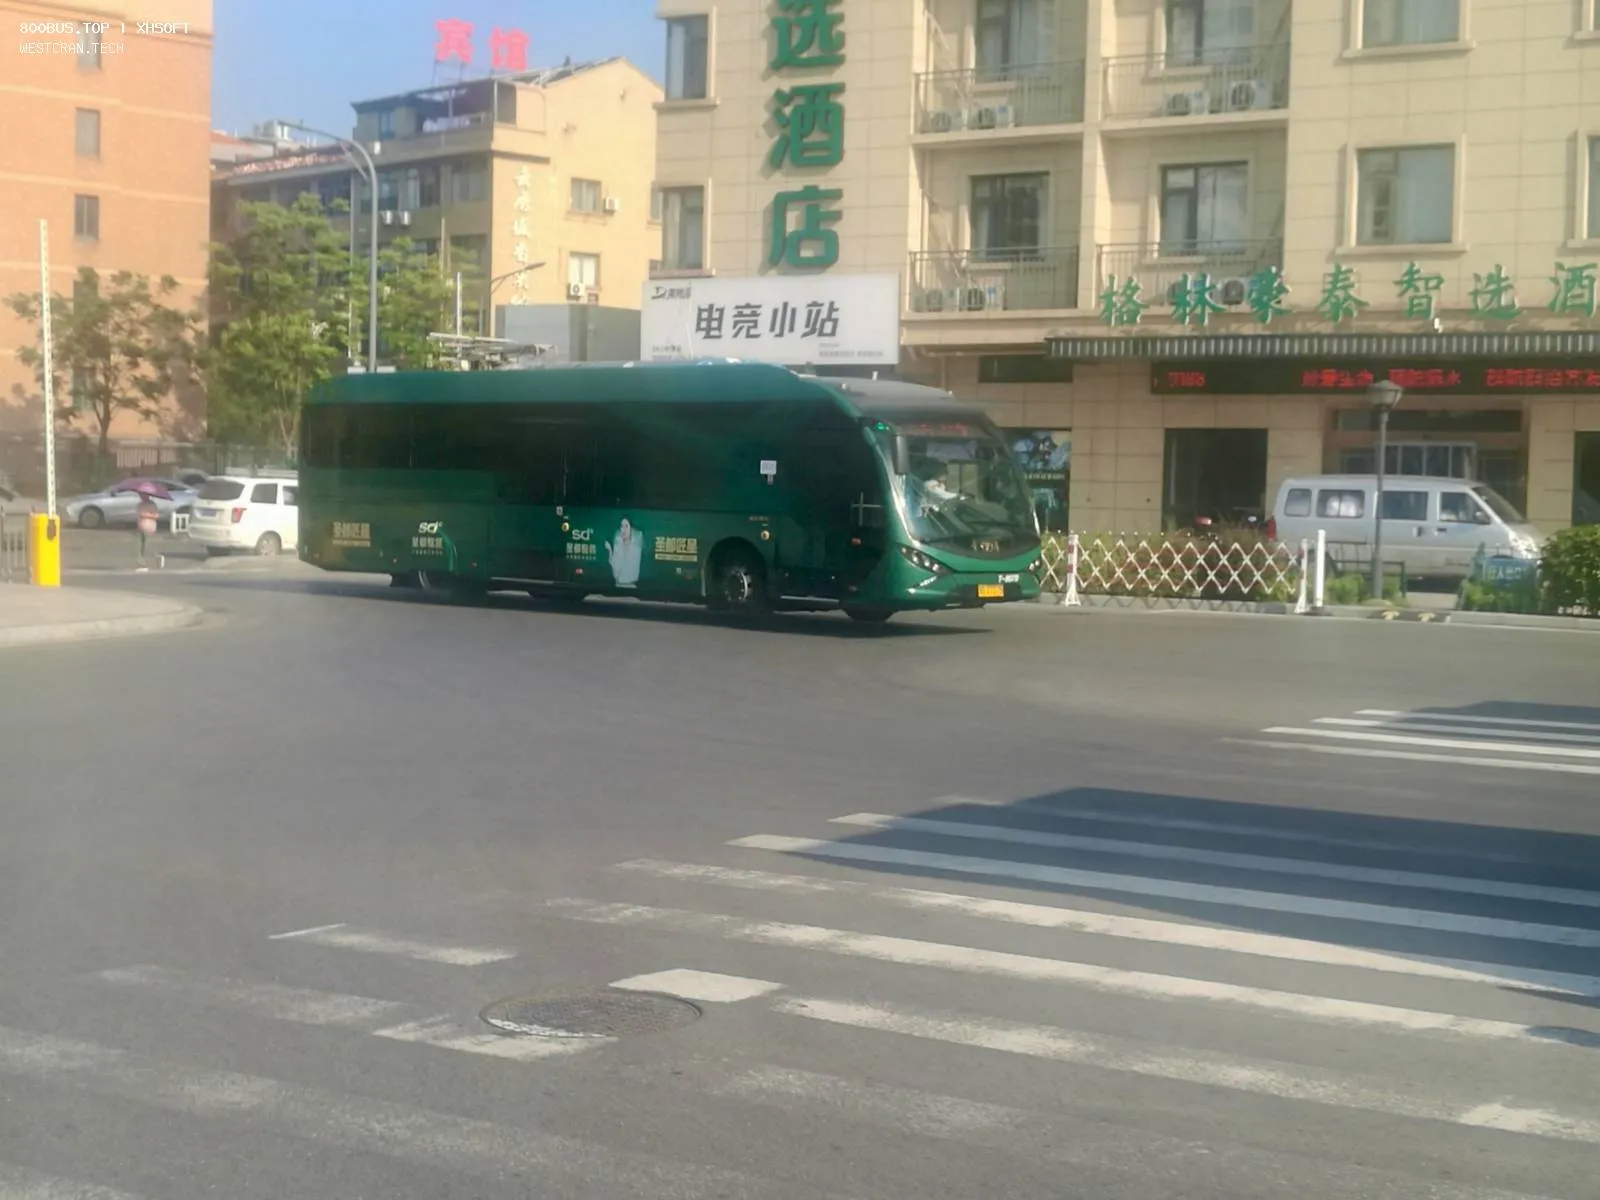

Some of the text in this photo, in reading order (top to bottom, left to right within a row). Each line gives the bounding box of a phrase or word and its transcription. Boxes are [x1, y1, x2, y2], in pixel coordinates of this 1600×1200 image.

[769, 0, 846, 269] 选酒店
[695, 301, 839, 340] 电竞小站
[1100, 261, 1598, 327] 格林豪泰智选酒
